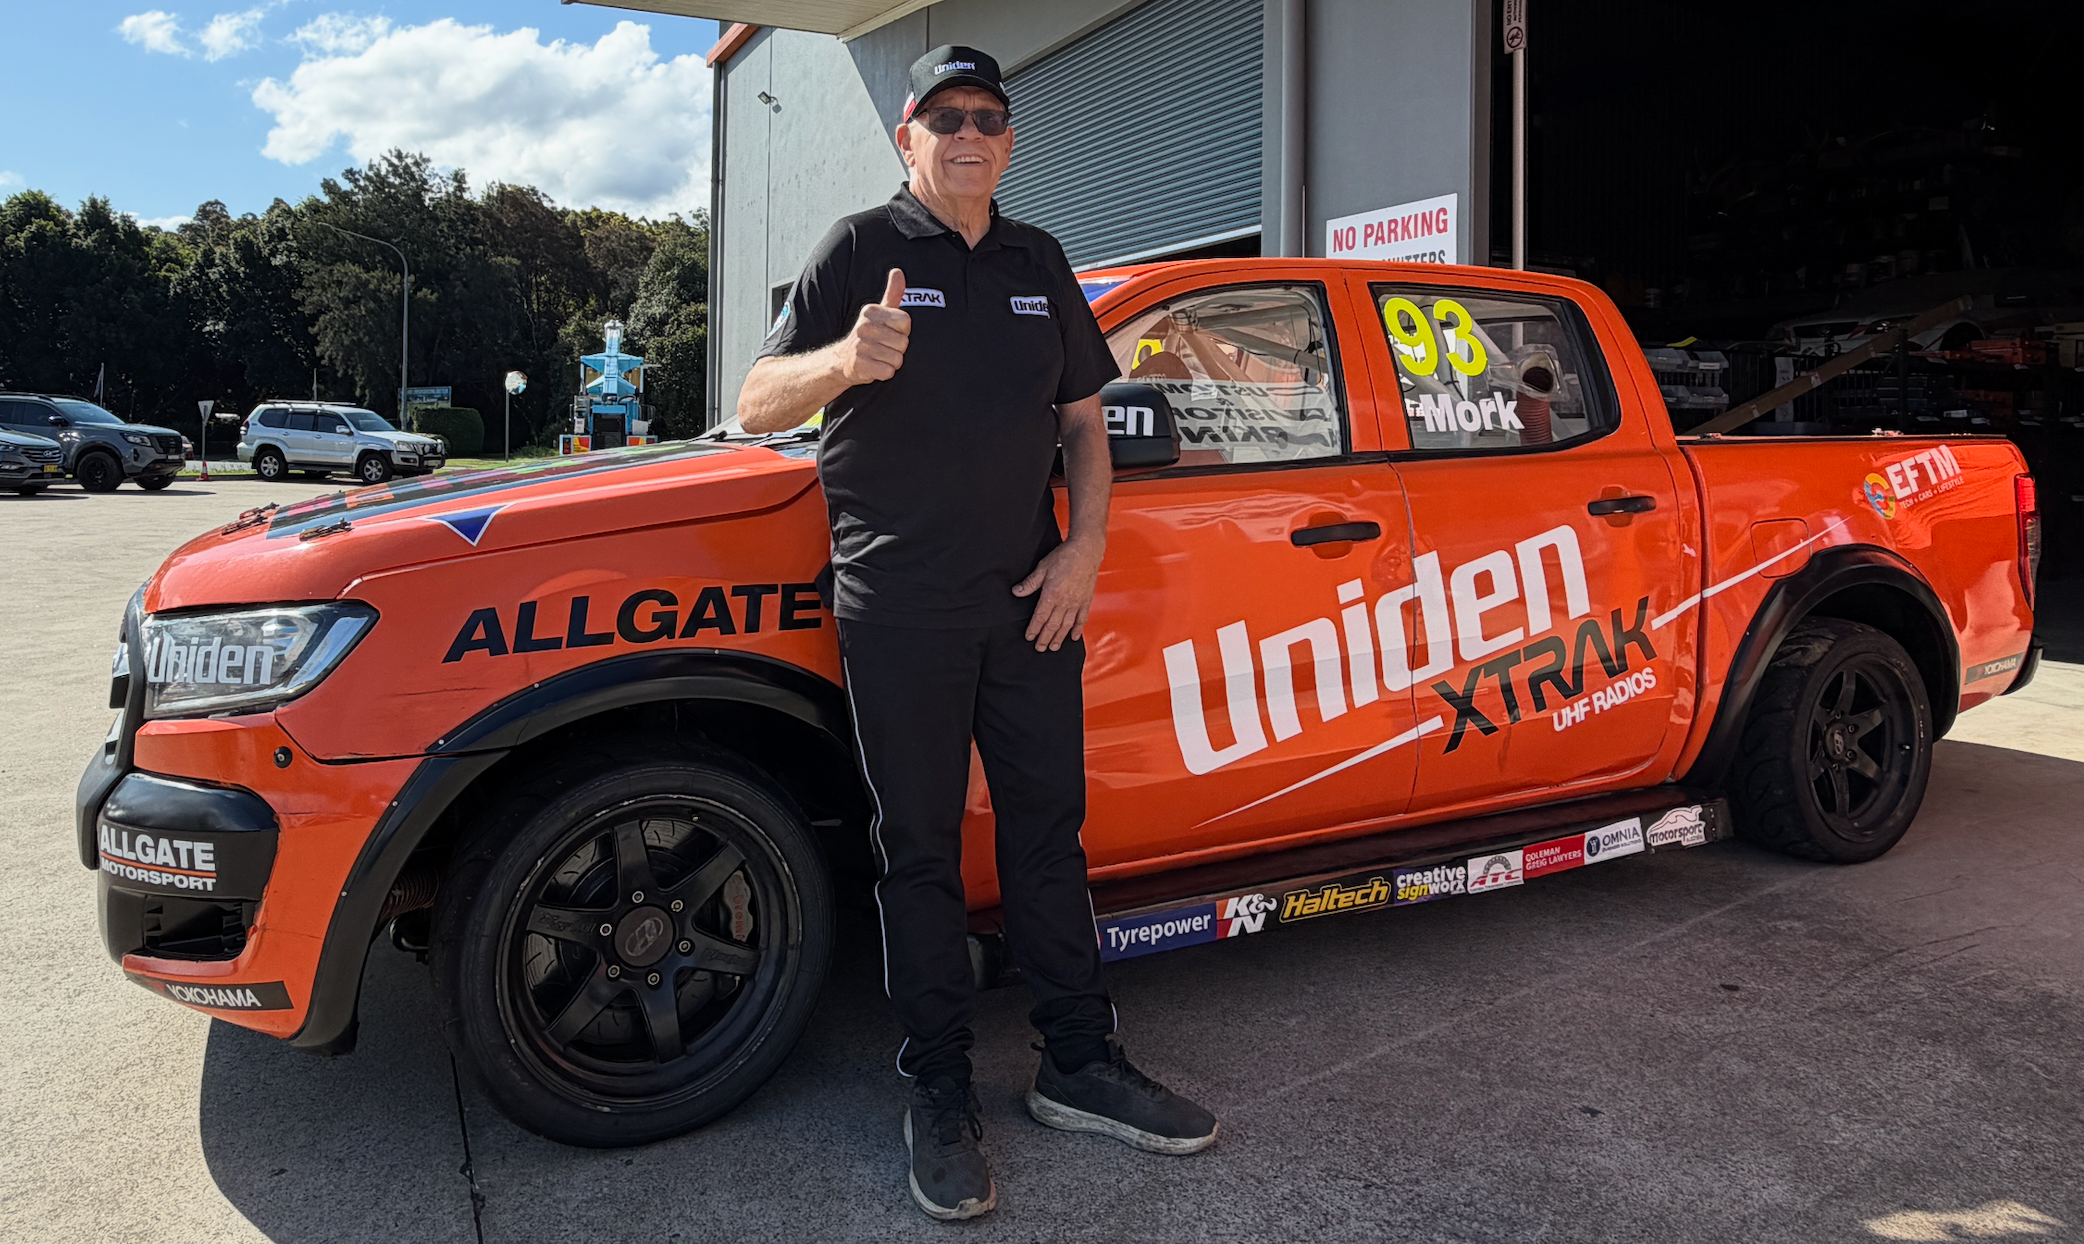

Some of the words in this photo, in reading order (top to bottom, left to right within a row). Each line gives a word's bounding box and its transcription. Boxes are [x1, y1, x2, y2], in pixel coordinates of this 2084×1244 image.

[934, 61, 976, 75] Uniden
[1333, 228, 1356, 253] NO
[1363, 207, 1448, 248] PARKING
[1014, 300, 1050, 312] Unide
[1384, 297, 1488, 376] 93
[1419, 391, 1525, 432] Mork
[1885, 444, 1961, 500] EFTM
[441, 581, 824, 664] ALLGATE
[148, 633, 275, 684] Uniden
[1163, 524, 1591, 775] Uniden
[1431, 595, 1658, 755] XTRAK
[1552, 697, 1591, 732] UHF
[1592, 667, 1657, 715] RADIOS
[101, 824, 216, 871] ALLGATE
[1525, 846, 1561, 862] COLEMAN
[1602, 826, 1641, 847] OMNIA
[101, 858, 216, 891] MOTORSPORT
[1396, 866, 1466, 888] creative
[1470, 868, 1522, 887] ATC
[1525, 858, 1548, 871] GREIG
[1548, 849, 1582, 864] LAWYERS
[1282, 880, 1388, 919] Haltech
[1397, 878, 1466, 901] signworx
[1107, 913, 1211, 952] Tyrepower
[166, 984, 262, 1007] YOKOHAMA
